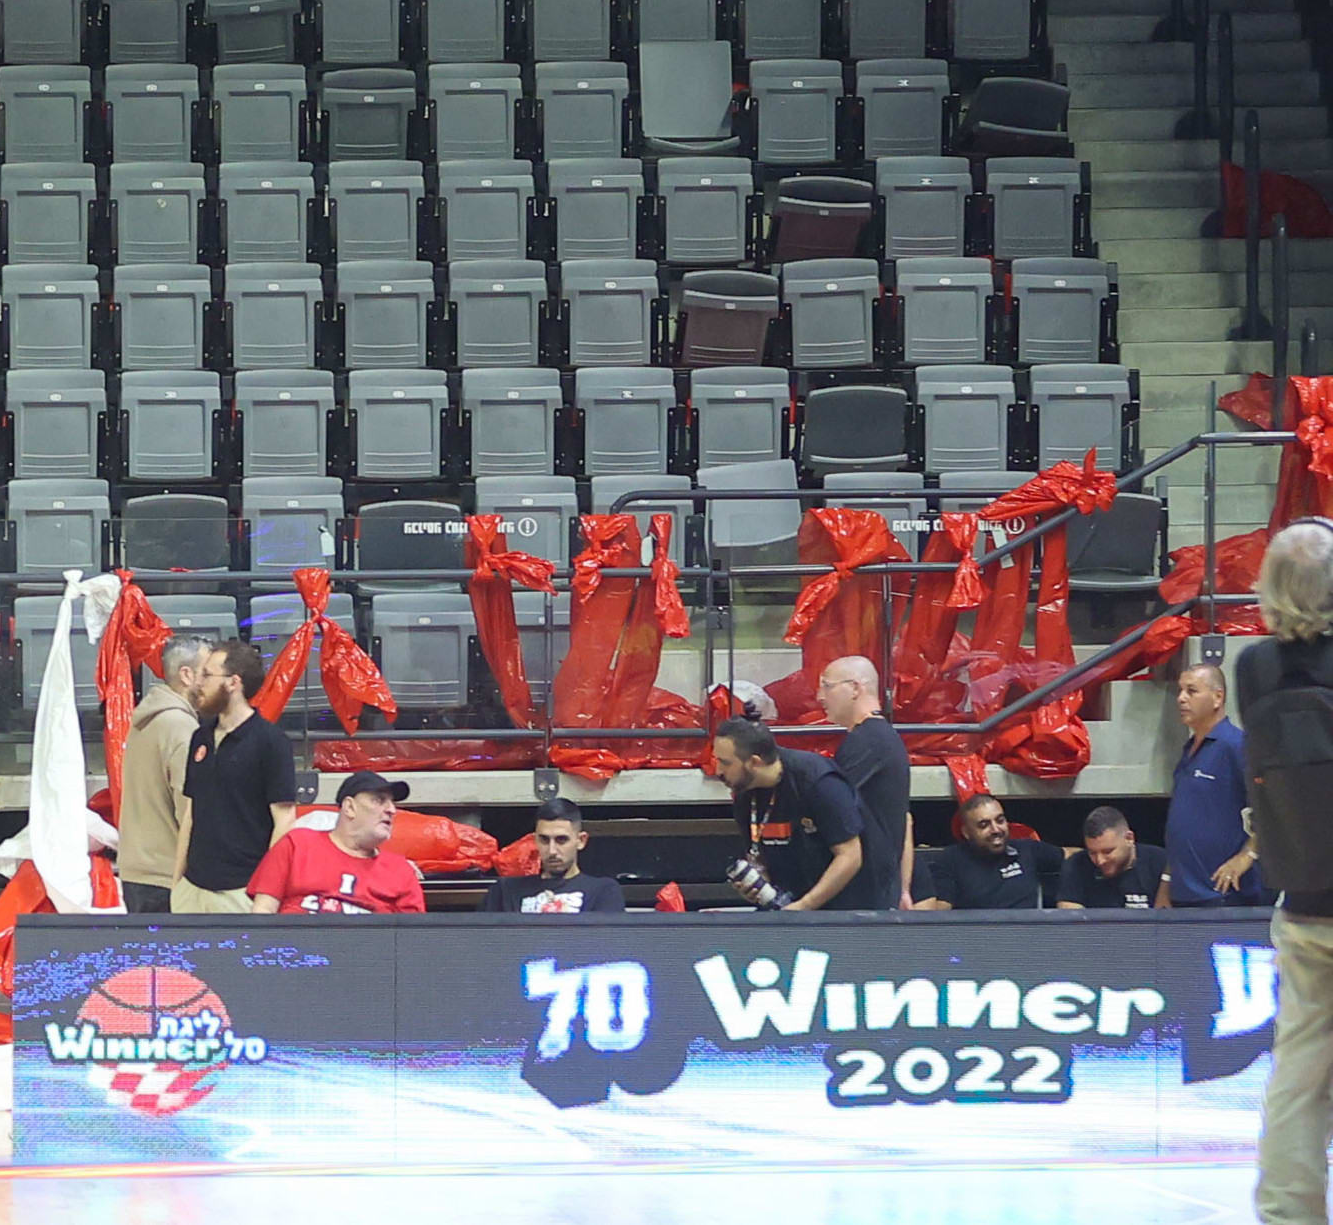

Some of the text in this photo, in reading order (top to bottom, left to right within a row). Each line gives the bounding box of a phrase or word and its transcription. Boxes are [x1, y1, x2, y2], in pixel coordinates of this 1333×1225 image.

[693, 947, 1165, 1041] Winner
[43, 1022, 267, 1061] Winner סל
[156, 1009, 222, 1039] ליגת
[833, 1045, 1063, 1098] 2022
